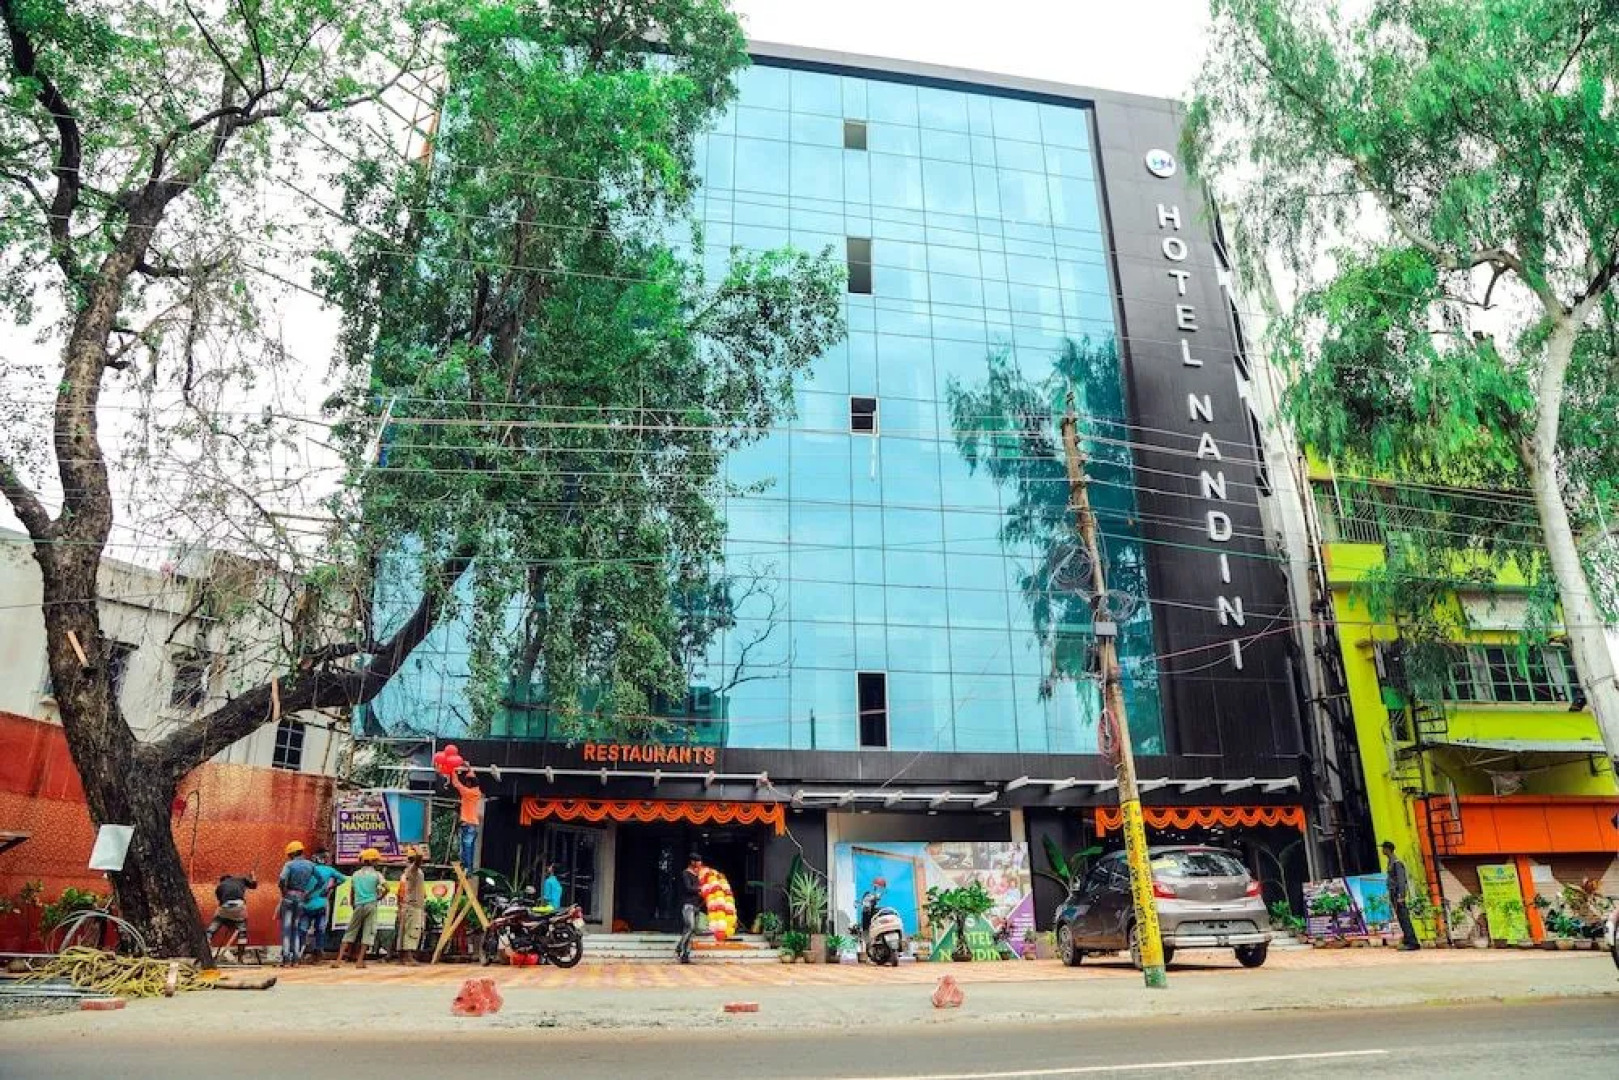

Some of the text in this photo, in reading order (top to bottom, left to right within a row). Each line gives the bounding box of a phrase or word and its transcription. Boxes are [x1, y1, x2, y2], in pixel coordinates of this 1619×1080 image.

[1157, 203, 1246, 671] HOTEL NANDINI
[583, 743, 716, 765] RESTAURANTS
[352, 813, 382, 822] HOTEL
[951, 931, 992, 945] HTEL
